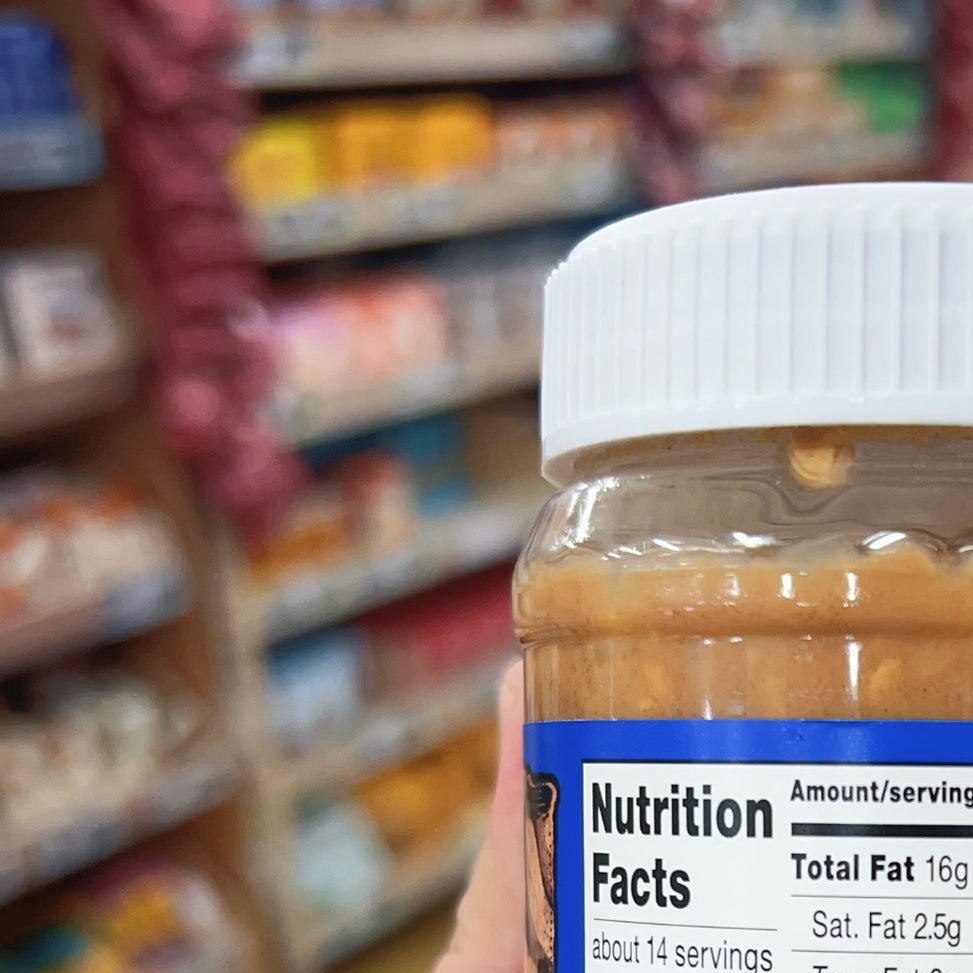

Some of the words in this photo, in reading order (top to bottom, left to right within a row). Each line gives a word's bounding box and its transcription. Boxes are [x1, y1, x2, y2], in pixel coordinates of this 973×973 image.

[592, 783, 773, 838] Nutrition
[593, 852, 691, 909] Facts
[791, 853, 859, 881] Total
[871, 854, 915, 882] Fat
[926, 855, 969, 890] 16g
[812, 910, 858, 938] Sat.
[869, 912, 905, 939] Fat
[914, 912, 962, 947] 2.5g
[592, 931, 640, 963] about
[647, 936, 668, 966] 14
